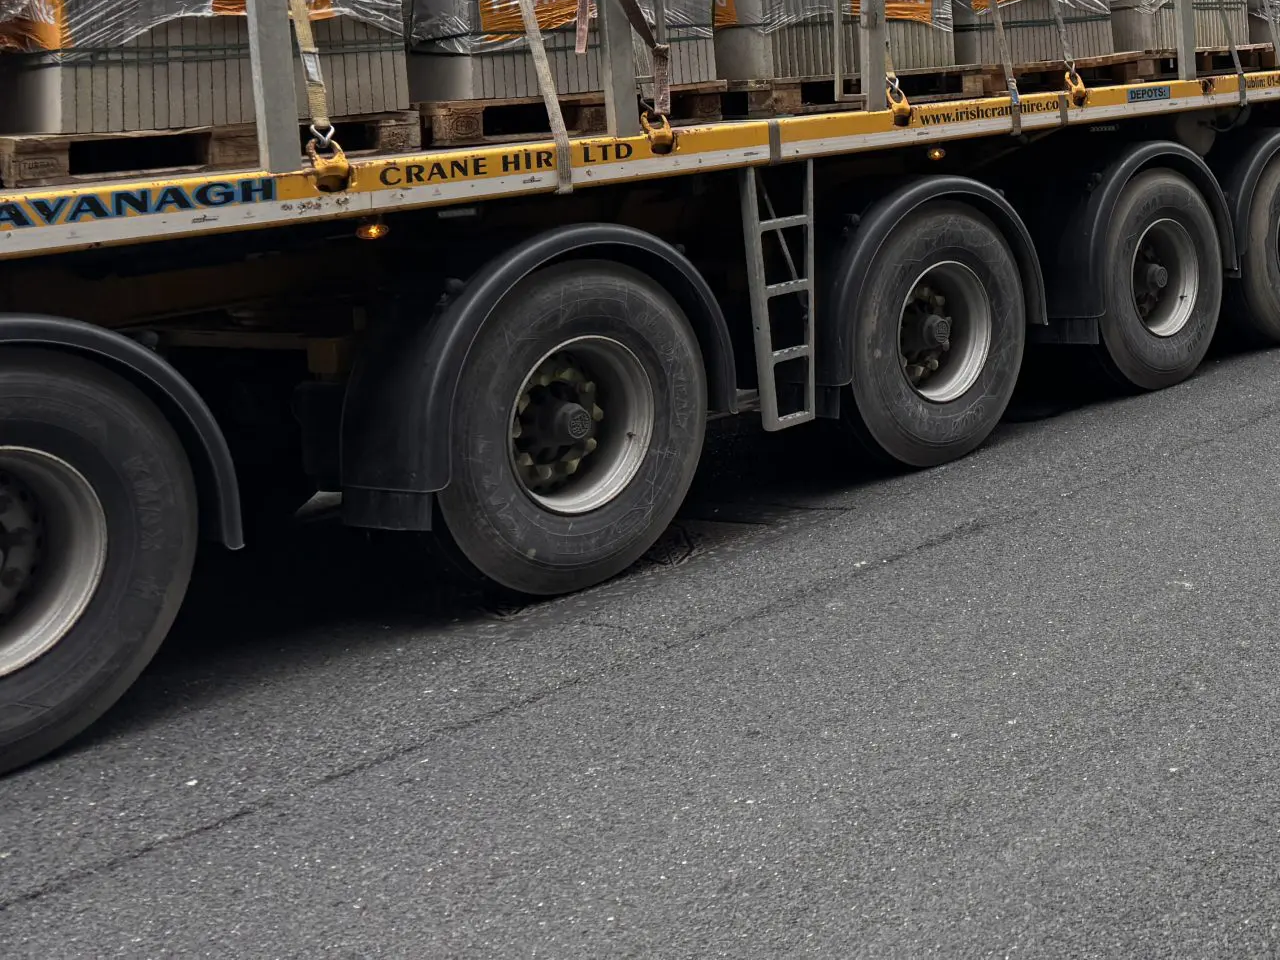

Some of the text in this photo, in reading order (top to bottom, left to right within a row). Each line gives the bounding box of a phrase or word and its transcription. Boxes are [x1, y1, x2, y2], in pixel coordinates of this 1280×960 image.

[1244, 76, 1265, 89] ublin:
[1129, 87, 1167, 100] DEPOTS:
[920, 99, 1070, 126] www.irishcranhire.co
[379, 142, 633, 186] CRANE HIR LTD
